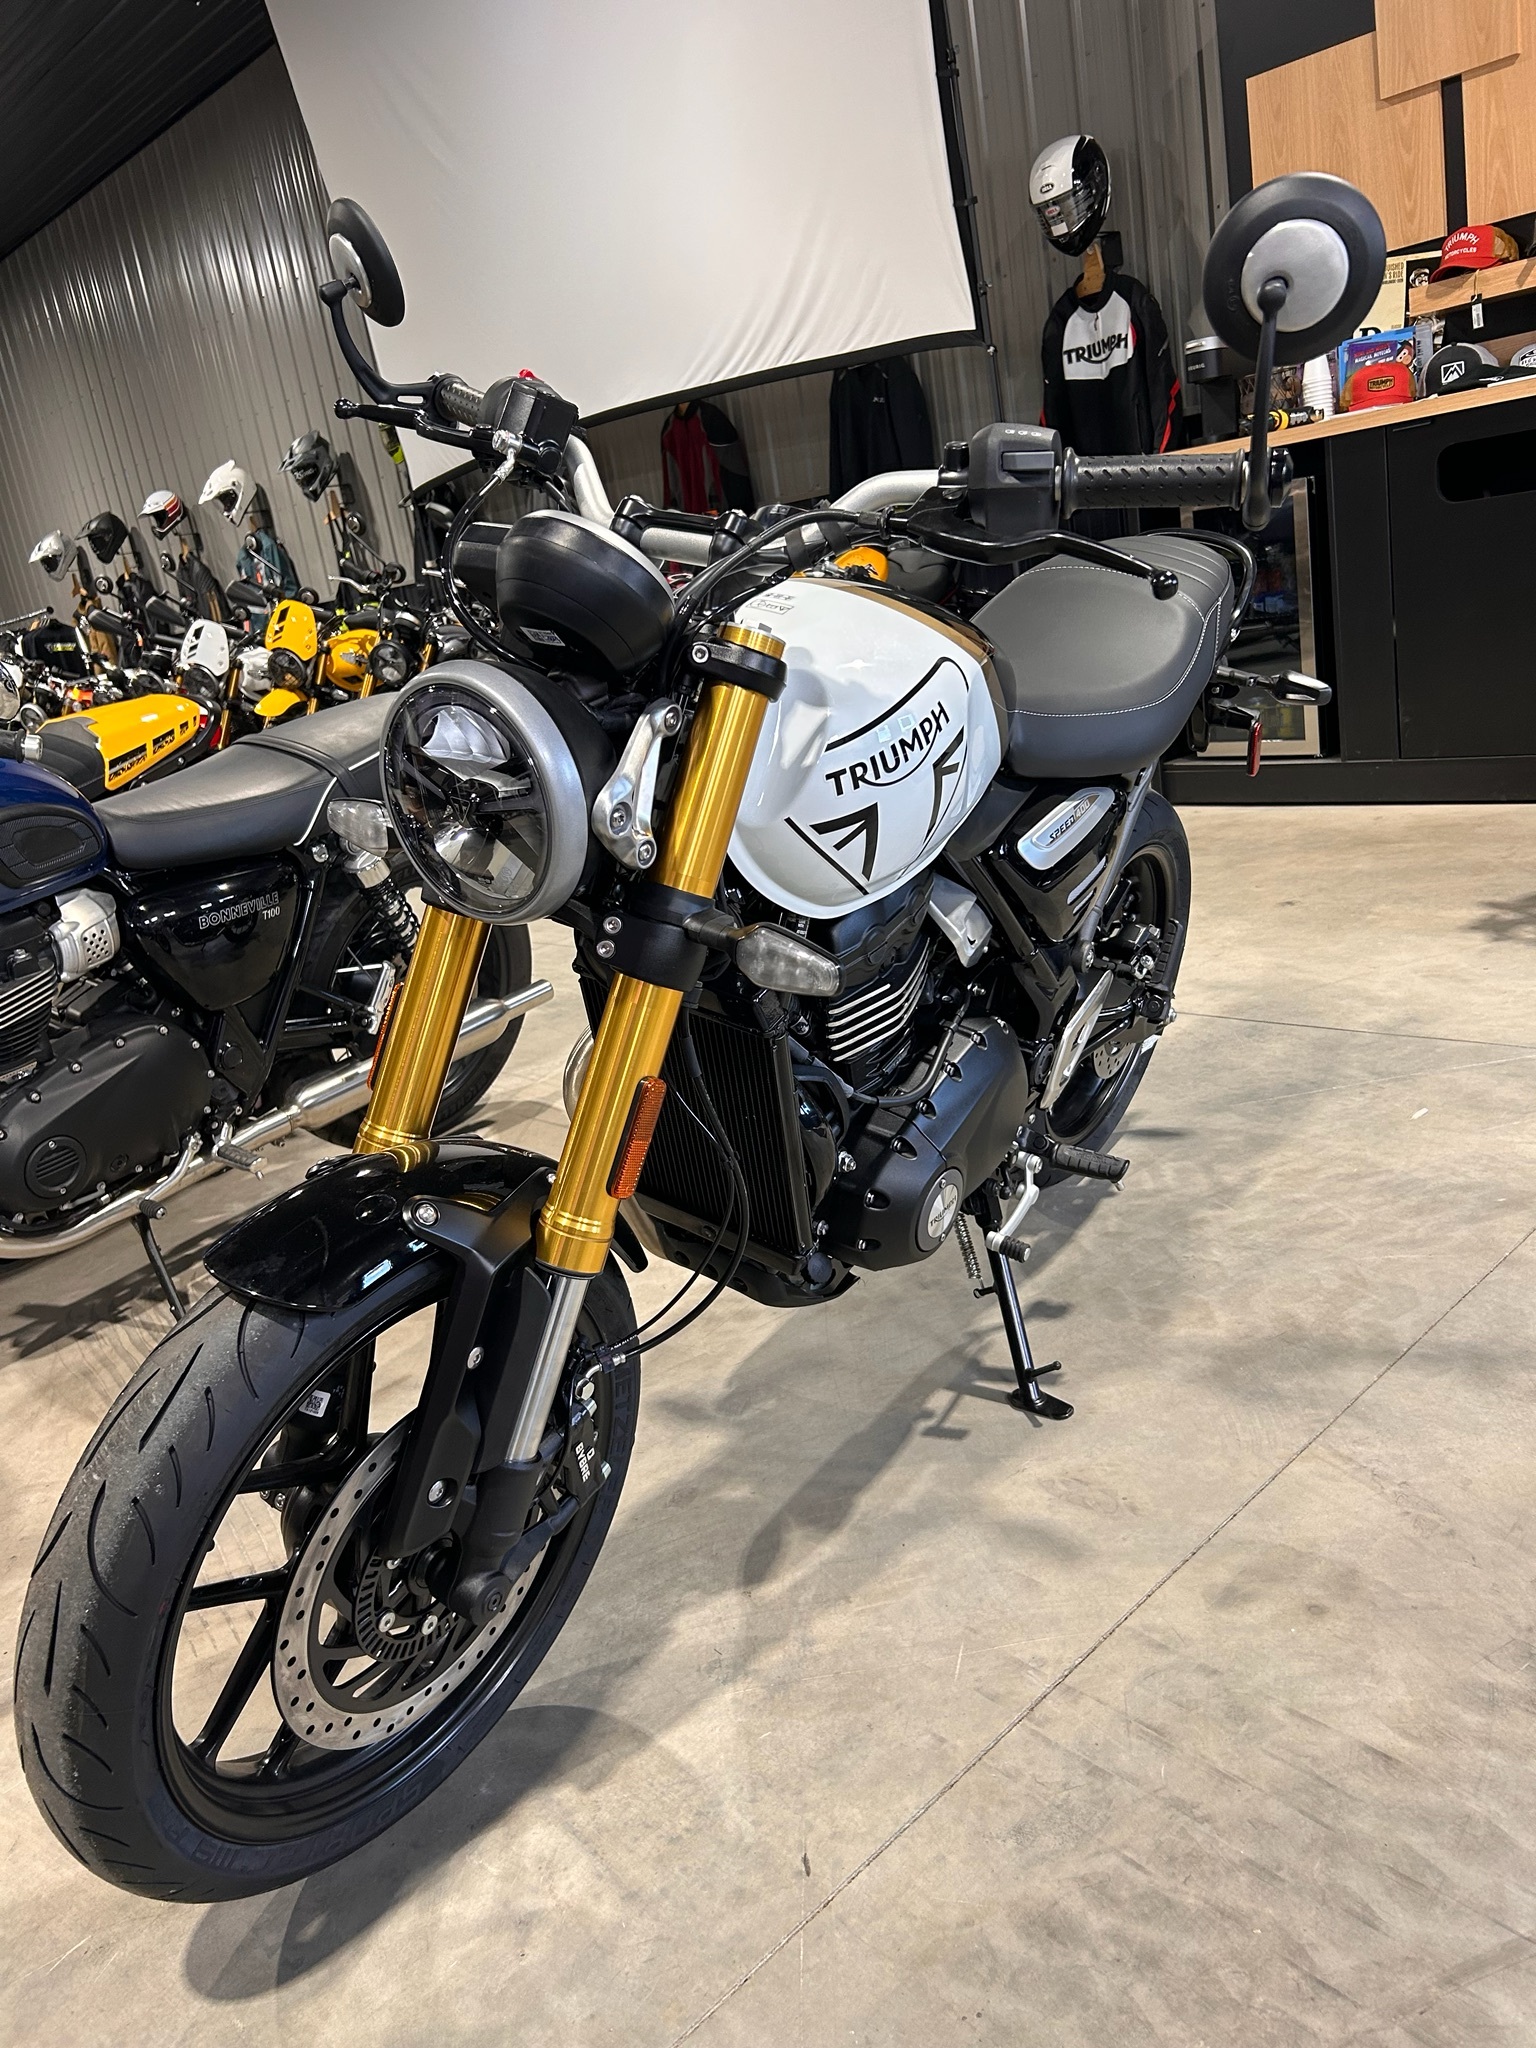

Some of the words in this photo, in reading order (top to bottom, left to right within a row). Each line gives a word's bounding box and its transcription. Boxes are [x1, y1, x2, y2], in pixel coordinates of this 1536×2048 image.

[1445, 232, 1480, 251] TRIUMPH
[1063, 333, 1129, 364] TRIUMPH
[825, 700, 950, 796] TRIUMPH
[1074, 799, 1091, 819] 400
[198, 891, 279, 930] BONNEVILLE
[262, 906, 280, 920] T100
[930, 1195, 957, 1227] TRIUMPH
[576, 1442, 590, 1482] BYBRE
